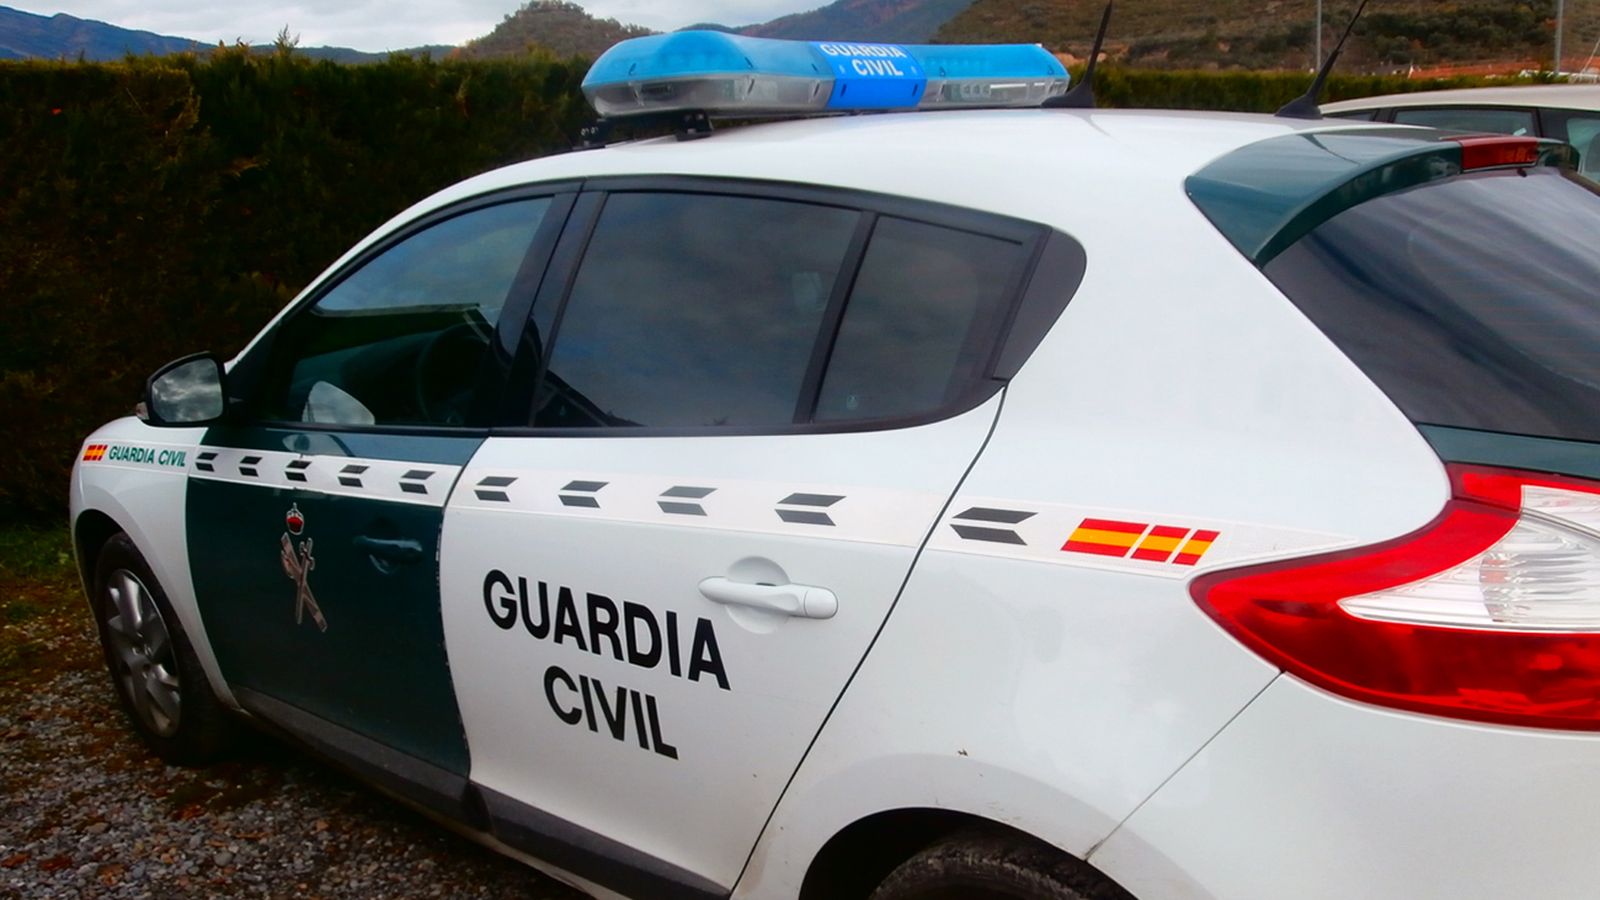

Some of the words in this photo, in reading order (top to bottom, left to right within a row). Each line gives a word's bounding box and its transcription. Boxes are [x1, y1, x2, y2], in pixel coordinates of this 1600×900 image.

[820, 44, 907, 58] GUARDIA
[851, 59, 904, 76] CIVIL
[108, 446, 155, 464] GUARDIA
[158, 449, 187, 467] CIVIL
[483, 569, 731, 690] GUARDIA
[543, 665, 678, 760] CIVIL
